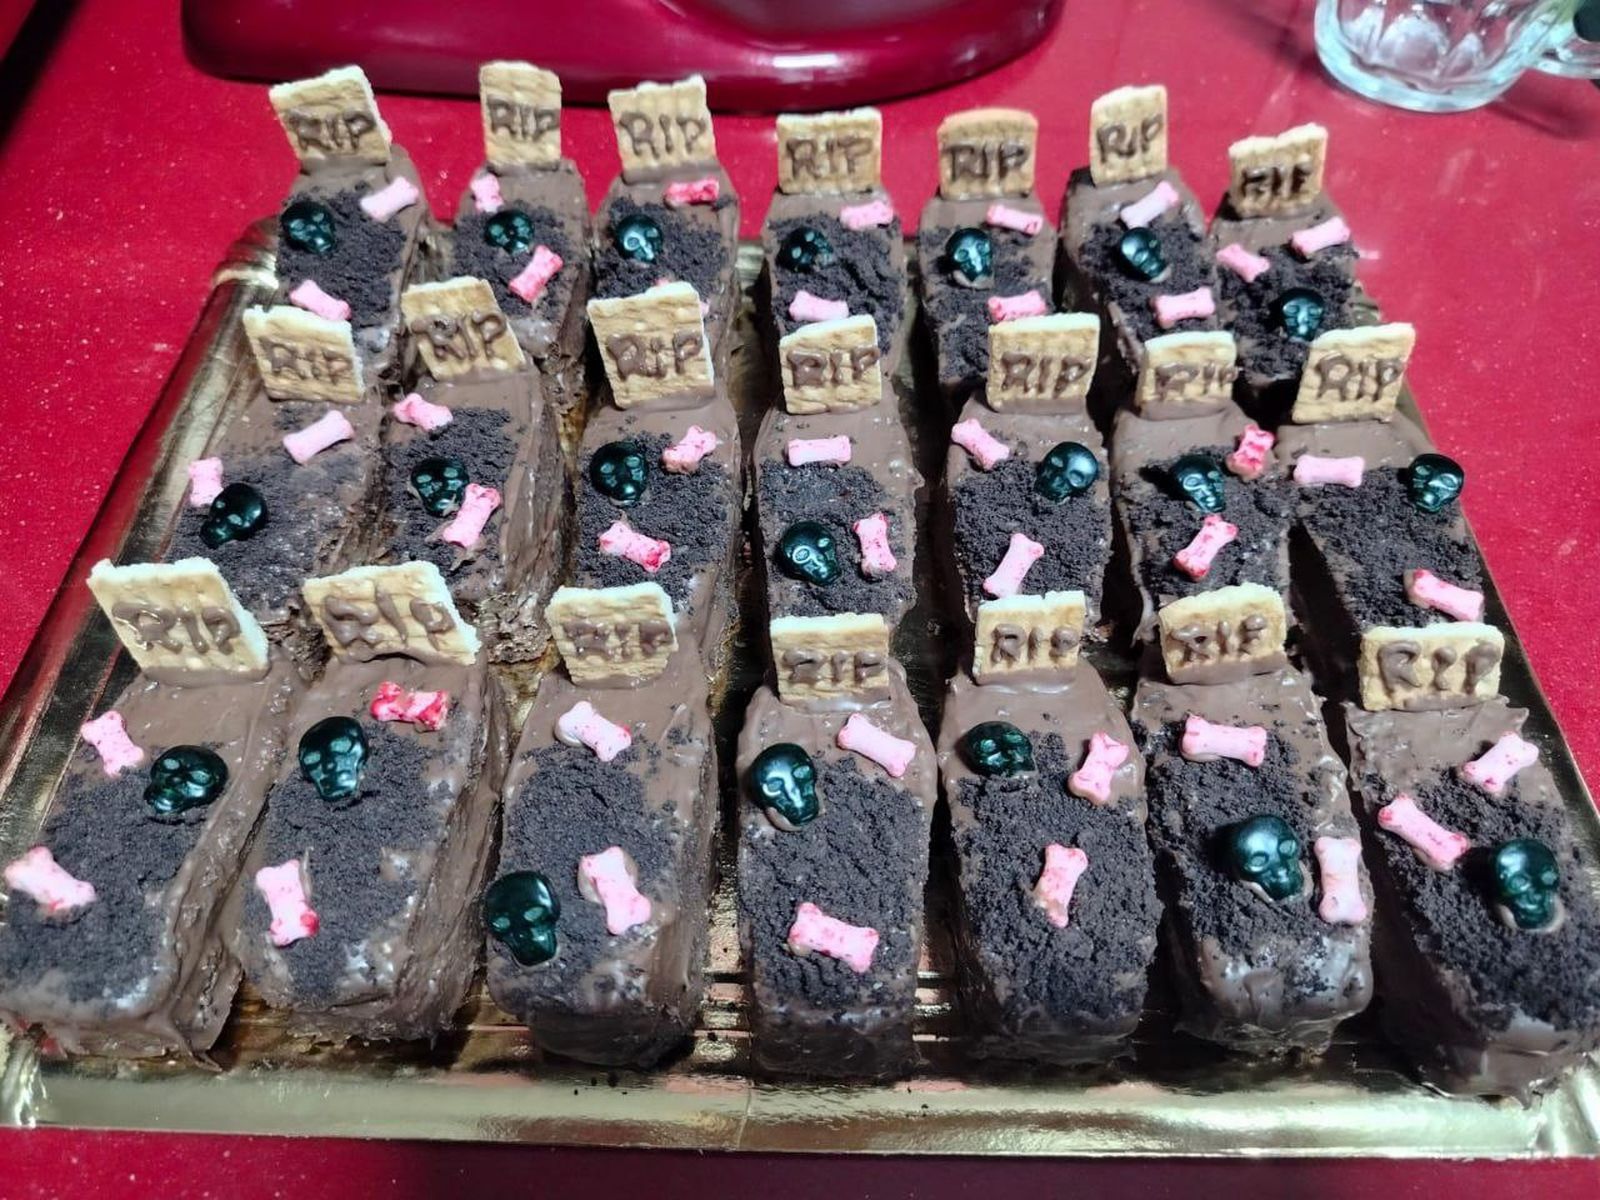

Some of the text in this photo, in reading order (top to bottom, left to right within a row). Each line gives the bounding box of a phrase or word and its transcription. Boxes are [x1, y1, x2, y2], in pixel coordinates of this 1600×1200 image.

[283, 109, 376, 149] RIP
[485, 99, 560, 140] RIP
[619, 112, 706, 159] RIP
[1097, 114, 1162, 164] RIP
[786, 136, 873, 179] RIP
[947, 144, 1030, 181] RIP
[411, 312, 504, 361] RIP
[608, 332, 702, 380] RIP
[259, 337, 353, 386] RIP
[791, 349, 881, 389] RIP
[1002, 354, 1091, 397] RIP
[1156, 361, 1238, 400] RIP
[1316, 355, 1400, 401] RIP
[112, 601, 242, 651] RIP
[324, 592, 455, 653] RIP
[990, 623, 1081, 666] RIP
[783, 649, 885, 686] RIP
